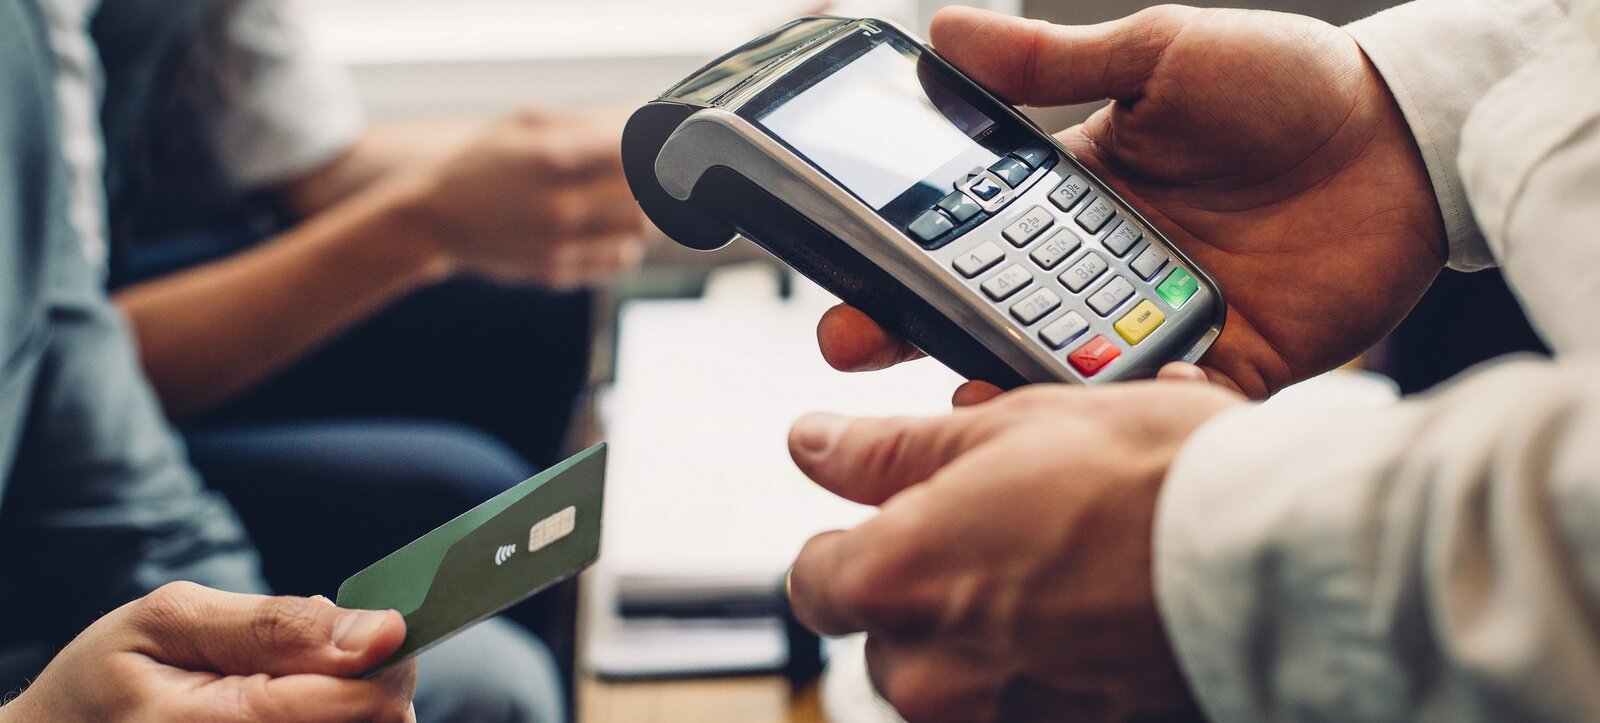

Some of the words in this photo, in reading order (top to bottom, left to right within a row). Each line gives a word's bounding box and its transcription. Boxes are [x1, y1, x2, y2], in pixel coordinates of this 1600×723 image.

[1060, 188, 1074, 200] 3
[1019, 222, 1033, 234] 2
[1045, 245, 1059, 255] 5
[970, 254, 983, 264] 1
[1075, 268, 1089, 280] 8
[998, 278, 1009, 289] 4
[1137, 310, 1152, 324] CLEAR
